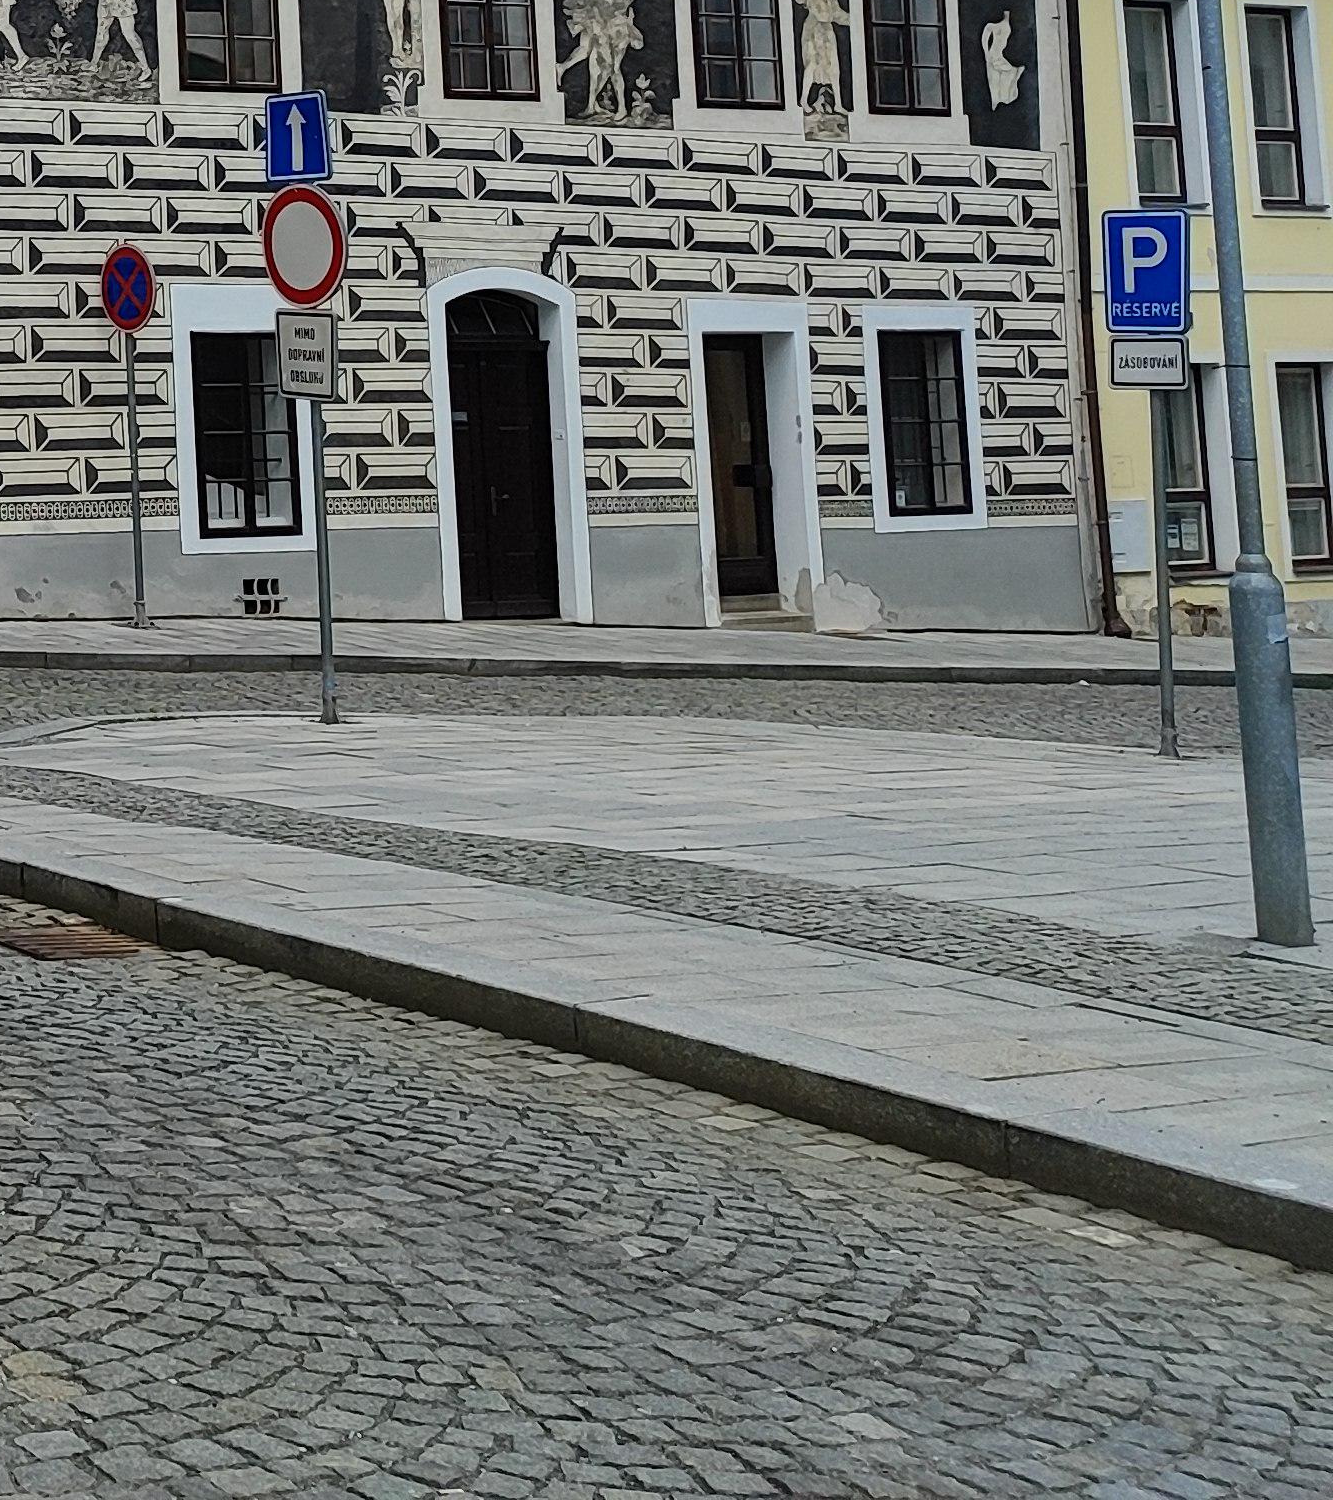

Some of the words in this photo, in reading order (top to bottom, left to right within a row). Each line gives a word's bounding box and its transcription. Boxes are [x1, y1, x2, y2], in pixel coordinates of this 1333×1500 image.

[1122, 227, 1168, 294] P
[1112, 300, 1180, 317] RÉSERVÉ
[294, 327, 315, 340] MIMO
[288, 348, 325, 363] DOPRAVNÍ
[1118, 353, 1178, 369] ZÁSOBOVÁNÍ
